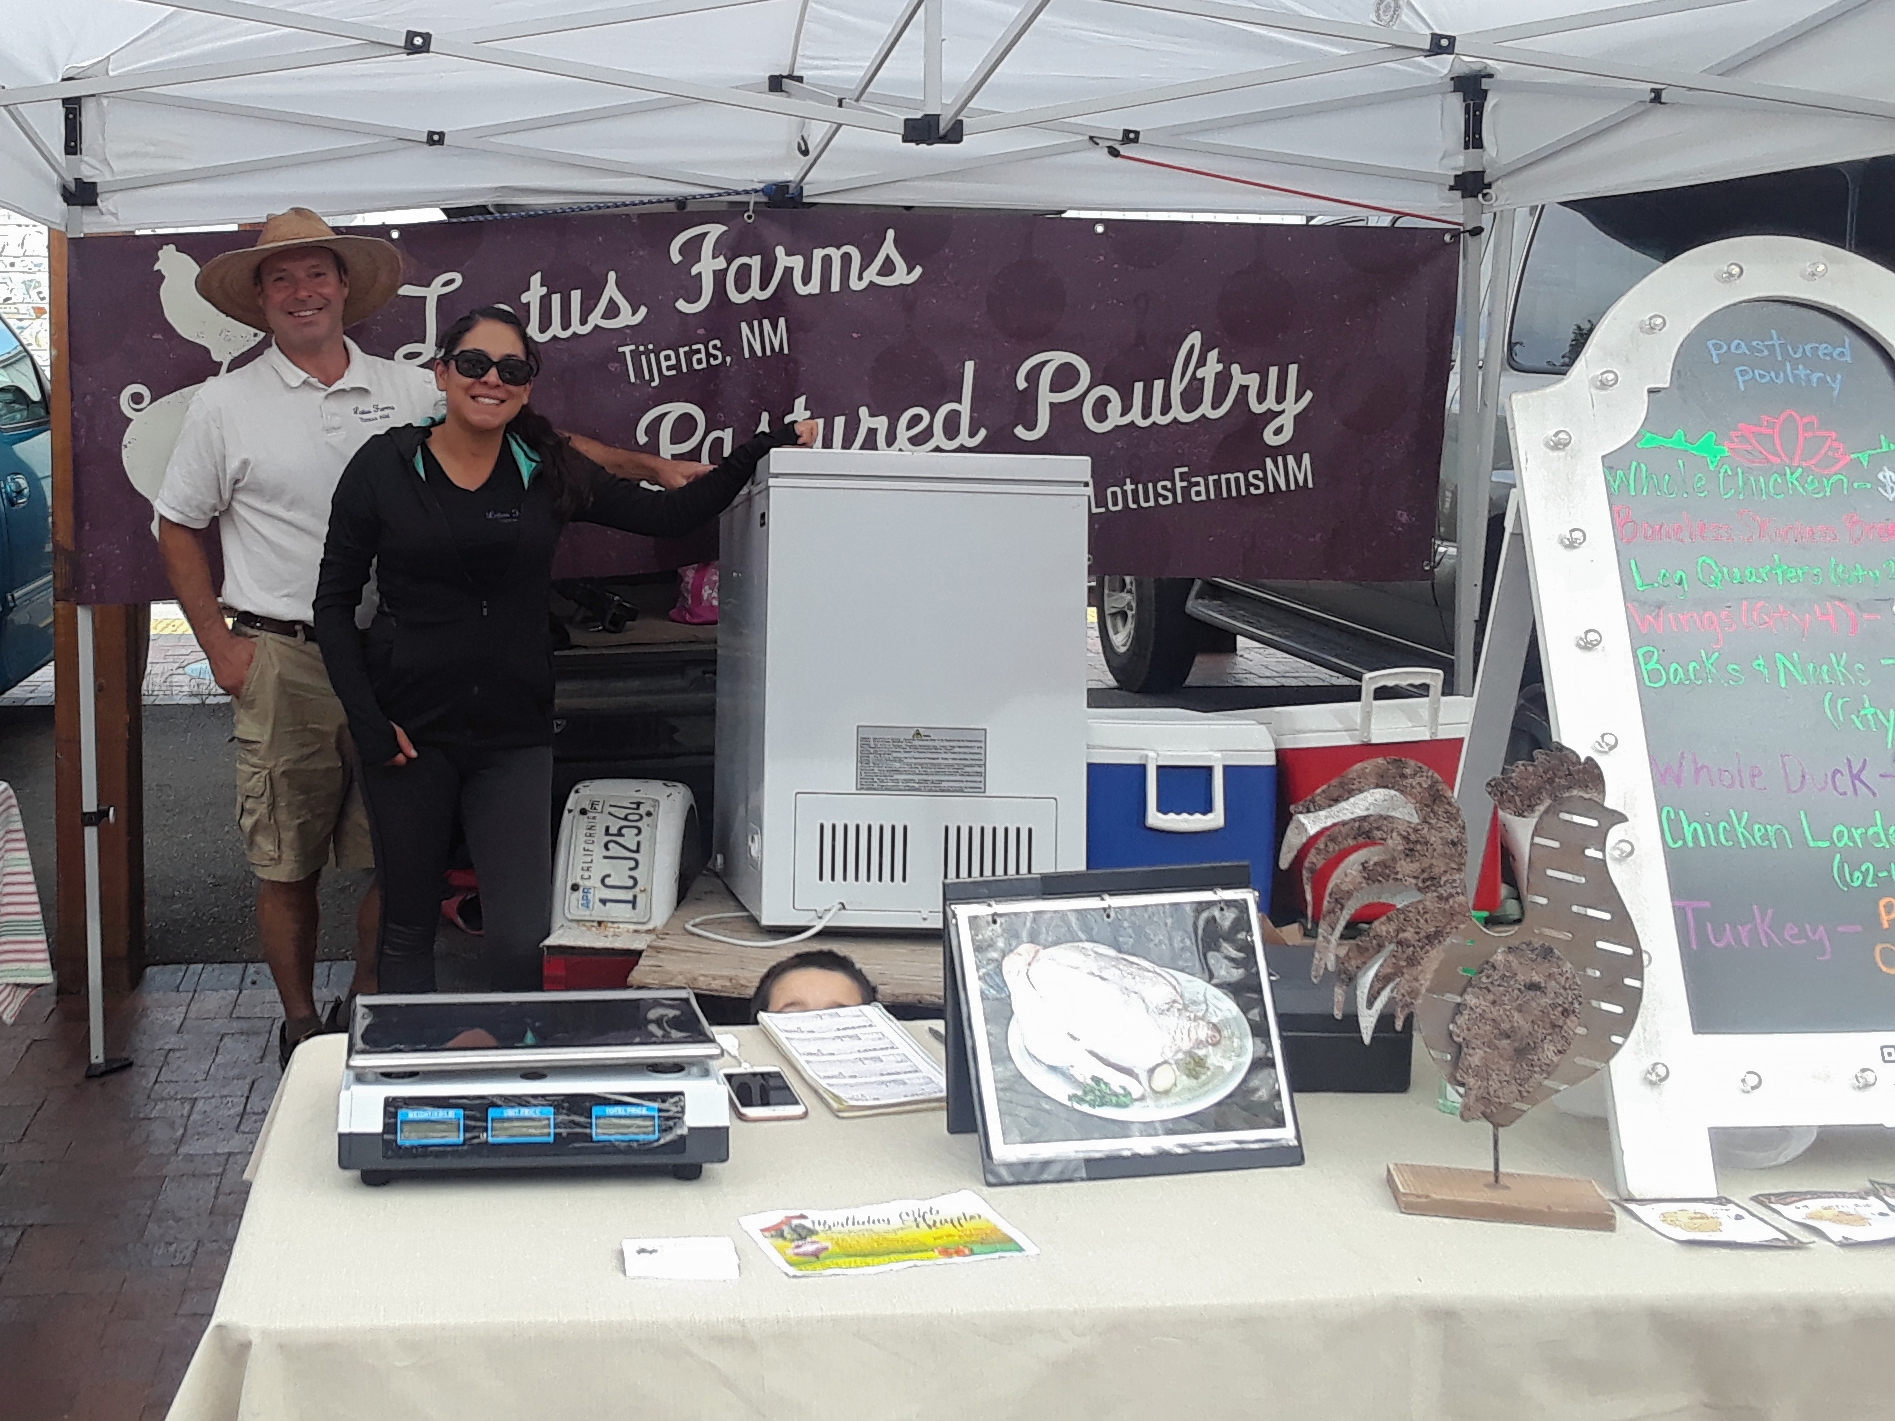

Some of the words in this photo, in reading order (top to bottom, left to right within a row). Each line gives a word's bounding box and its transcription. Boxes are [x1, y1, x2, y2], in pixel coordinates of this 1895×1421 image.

[394, 271, 648, 366] Ltus
[669, 223, 924, 314] Farms
[617, 338, 732, 387] Tijeras,
[740, 316, 789, 358] NM
[1706, 329, 1852, 364] pastured
[1013, 331, 1313, 446] Poultry
[1733, 361, 1843, 402] poultry
[1090, 453, 1313, 514] LotusFarmsNM
[1604, 460, 1708, 498] Whole
[1629, 557, 1689, 600] Leg
[1697, 552, 1824, 591] Quarters
[1637, 646, 1746, 688] Backs
[1775, 652, 1872, 688] Necks
[1651, 751, 1768, 792] Whole
[581, 815, 598, 881] CALIFORNIA
[1661, 806, 1793, 849] Chicken
[599, 800, 645, 911] 1CJ2564
